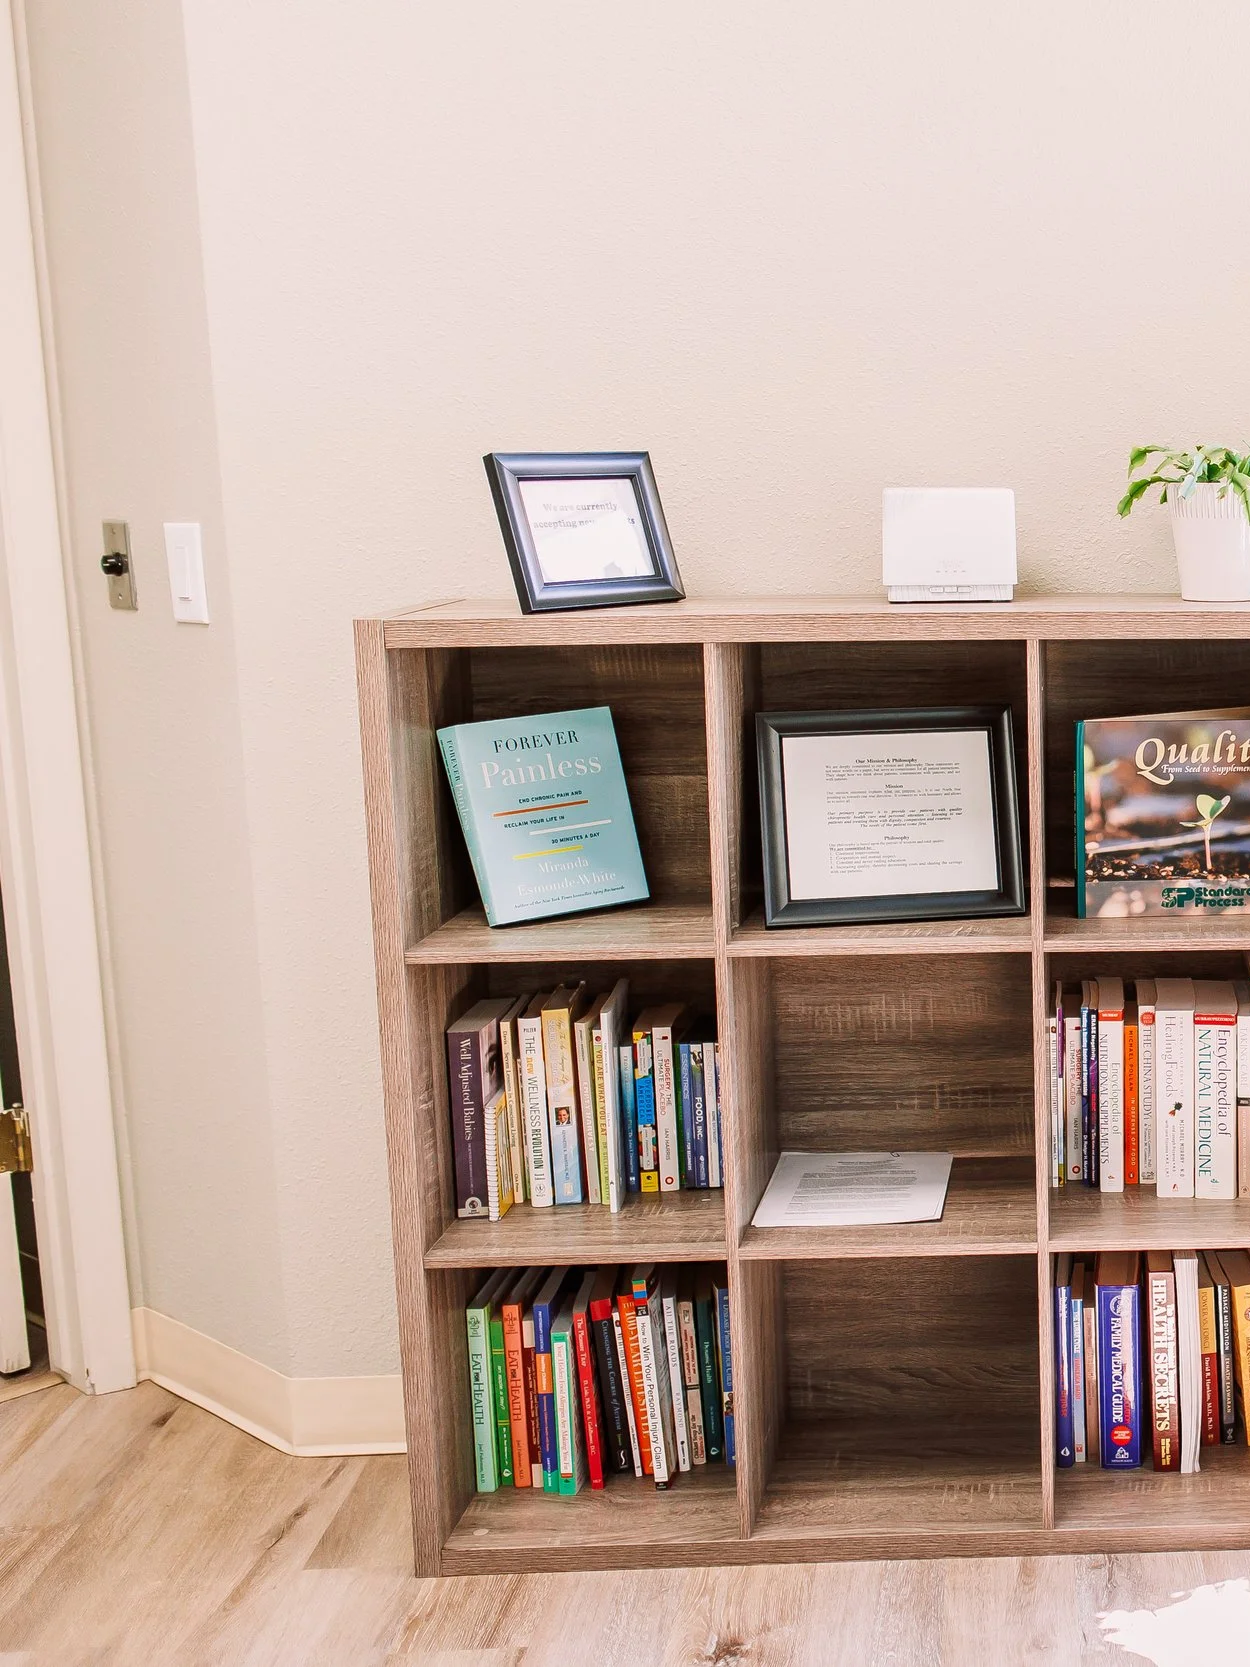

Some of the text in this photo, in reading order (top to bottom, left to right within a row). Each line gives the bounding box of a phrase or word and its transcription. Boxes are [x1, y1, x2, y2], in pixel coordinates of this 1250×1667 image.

[543, 502, 618, 513] We are currently
[533, 520, 578, 530] accepting
[493, 730, 580, 754] FOREVER
[447, 740, 461, 782] FOREVER
[479, 753, 602, 789] Painless
[1161, 764, 1184, 774] From
[1184, 763, 1201, 773] Seed
[1202, 764, 1210, 773] to
[455, 783, 470, 832] Painless
[531, 794, 556, 803] CHRONIC
[538, 856, 590, 874] Miranda
[517, 871, 616, 897] Esmonde-White
[460, 1038, 472, 1060] Well
[1143, 1026, 1152, 1048] THE
[504, 1052, 512, 1069] Seven
[1143, 1049, 1152, 1083] CHINA
[1160, 1016, 1178, 1098] Healing Foods
[1240, 1027, 1248, 1087] TAKING CARE
[458, 1061, 475, 1105] Adjusted
[505, 1070, 513, 1092] Lessons
[681, 1053, 690, 1100] ESSENTRICS
[1212, 1029, 1231, 1138] Encyclopedia of
[525, 1036, 545, 1170] THE new WELLNESS REVOLUTION
[598, 1082, 606, 1104] WHAT
[637, 1085, 645, 1119] AMERICA
[645, 1079, 653, 1124] OVERDOSED
[1099, 1033, 1110, 1165] NUTRITIONAL SUPPLEMENTS
[1109, 1062, 1122, 1136] Encyclopedia of
[1143, 1084, 1153, 1118] STUDY
[1198, 1029, 1212, 1177] NATURAL MEDICINE
[463, 1107, 476, 1141] Babies
[507, 1100, 515, 1128] Conscious
[582, 1081, 595, 1152] EMPTY HARVEST
[599, 1106, 607, 1121] YOU
[695, 1096, 704, 1125] FOOD,
[509, 1129, 517, 1148] Living
[600, 1123, 608, 1137] EAT
[1131, 1137, 1136, 1146] OF
[602, 1320, 610, 1356] CHANGING
[1111, 1317, 1122, 1349] FAMILY
[471, 1353, 483, 1373] EAT
[508, 1349, 519, 1370] EAT
[641, 1345, 650, 1361] Win
[669, 1339, 677, 1368] ROADS
[724, 1350, 732, 1367] YOUR
[1152, 1279, 1171, 1431] HEALTH SECRETS
[608, 1371, 617, 1396] COURSE
[625, 1310, 650, 1439] 100-YEAR LIFESTYLE
[643, 1362, 653, 1382] Your
[705, 1365, 713, 1384] Health
[1111, 1351, 1123, 1393] MEDICAL
[473, 1382, 485, 1425] HEALTH
[510, 1378, 522, 1421] HEALTH
[611, 1398, 619, 1406] of
[647, 1384, 658, 1420] Personal
[675, 1392, 684, 1428] RAYMOND
[1112, 1393, 1124, 1423] GUIDE
[614, 1406, 622, 1430] AUTISM
[649, 1421, 661, 1445] Injury
[653, 1446, 663, 1470] Claim
